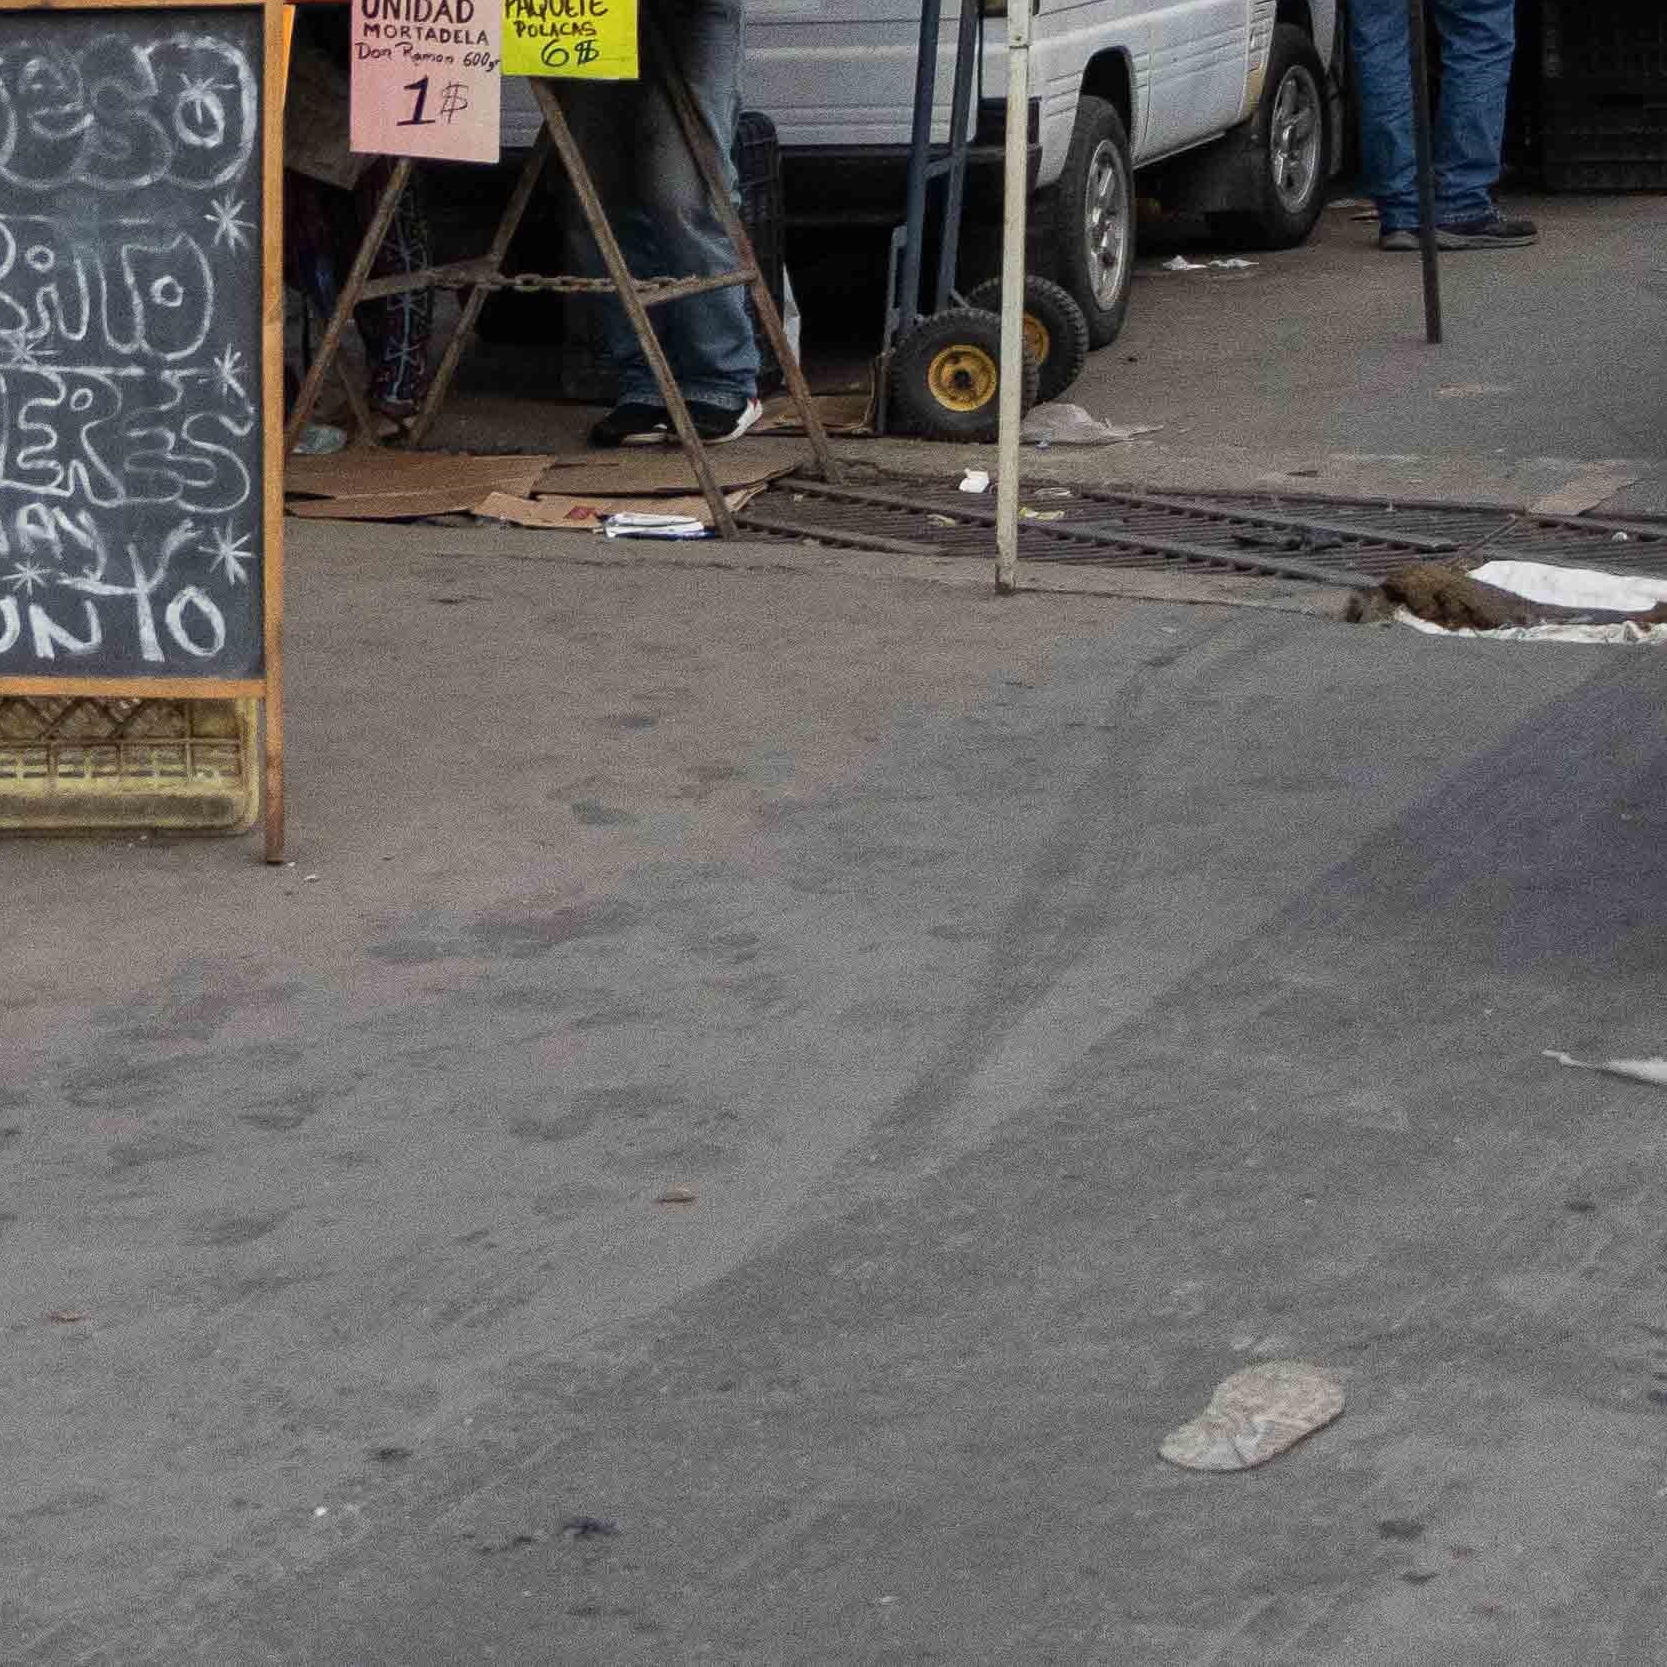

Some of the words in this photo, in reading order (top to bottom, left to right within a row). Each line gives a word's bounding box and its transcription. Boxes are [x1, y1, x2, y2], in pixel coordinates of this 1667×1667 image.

[363, 22, 490, 47] MORTADELA
[513, 20, 597, 39] POLACAS
[355, 41, 393, 61] Don
